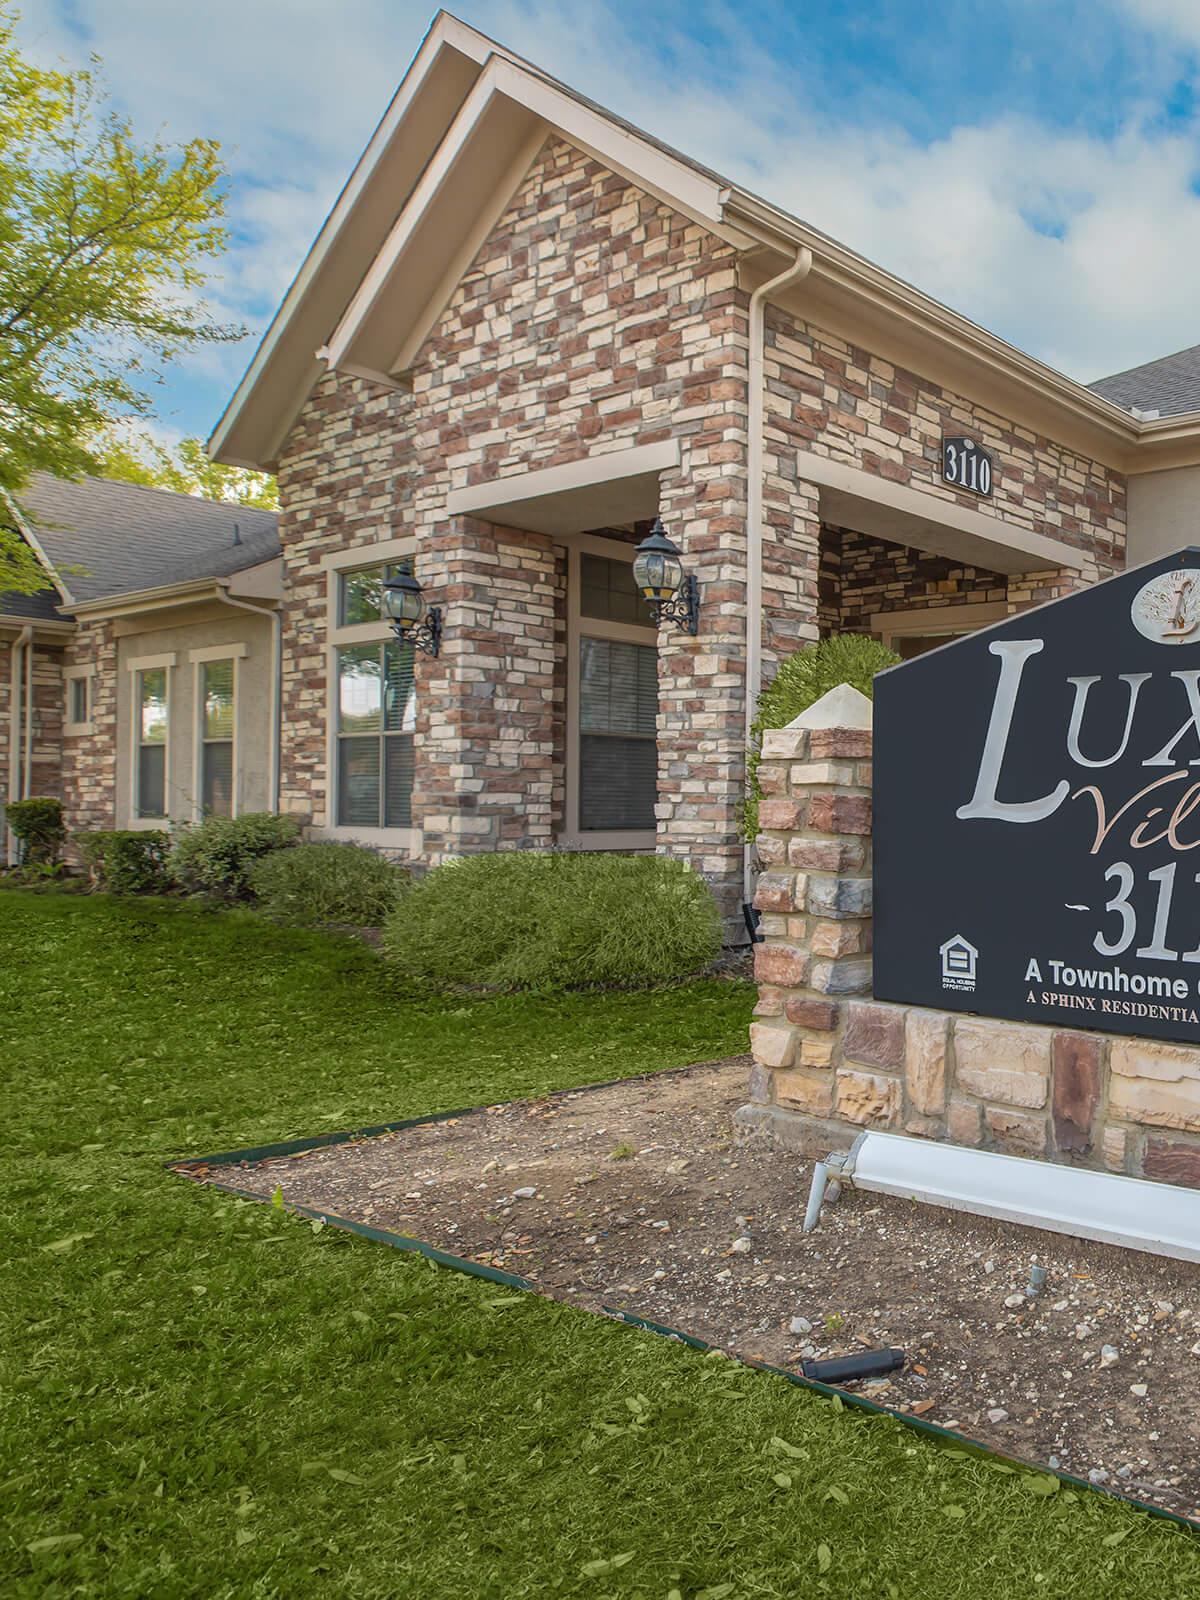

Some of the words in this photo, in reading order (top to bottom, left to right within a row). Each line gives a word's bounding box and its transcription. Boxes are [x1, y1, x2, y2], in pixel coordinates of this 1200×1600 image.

[946, 444, 991, 494] 3110
[1024, 958, 1043, 983] A
[1048, 959, 1189, 1000] Townhome
[1026, 991, 1037, 1004] A
[1041, 991, 1097, 1012] SPHINX
